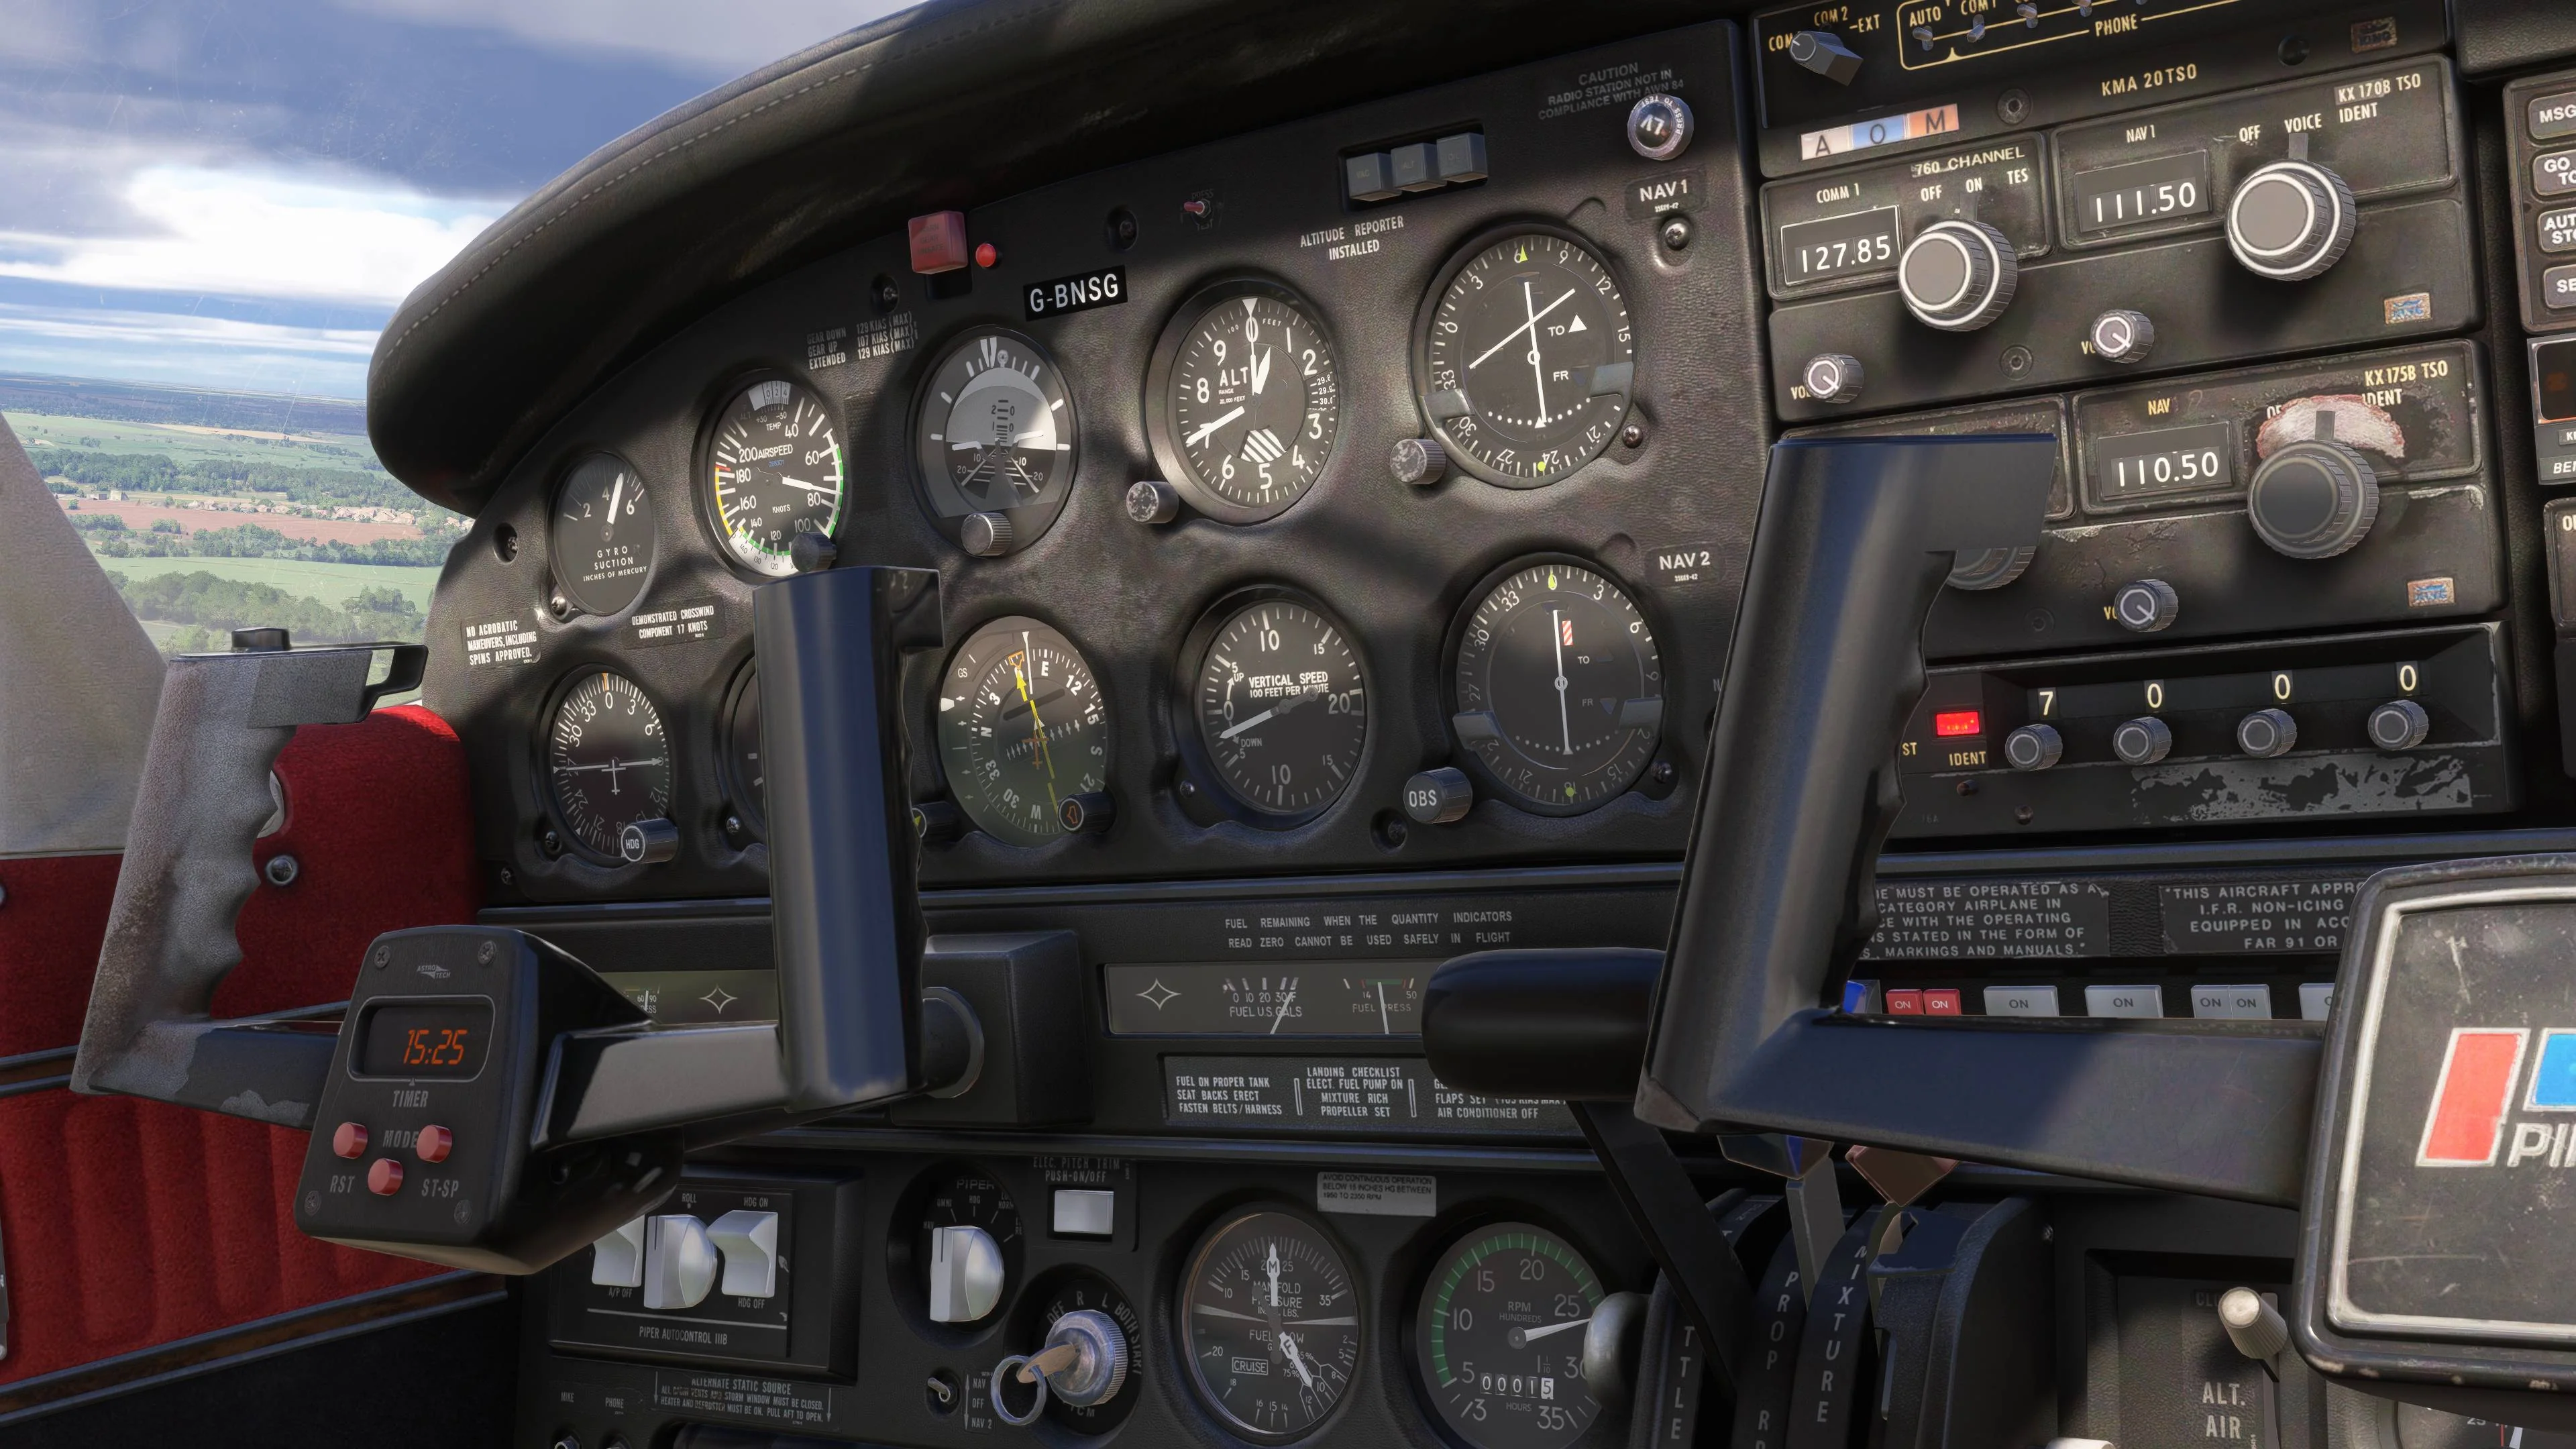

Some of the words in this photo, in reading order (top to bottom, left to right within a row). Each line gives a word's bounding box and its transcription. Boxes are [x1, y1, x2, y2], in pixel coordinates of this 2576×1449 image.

[1814, 9, 1836, 27] COM
[1839, 7, 1848, 21] 2
[1910, 6, 1941, 26] AUTO
[2095, 13, 2139, 37] PHONE
[1579, 62, 1638, 86] CAUTION
[2102, 74, 2137, 97] KMA
[2144, 70, 2162, 87] 20
[2165, 64, 2197, 83] TSO
[2339, 87, 2355, 103] KX
[2396, 74, 2421, 93] TSO
[1925, 110, 1945, 133] M
[2240, 124, 2261, 142] OFF
[2284, 113, 2322, 133] VOICE
[2339, 103, 2377, 123] IDENT
[2539, 104, 2576, 123] MSG
[2127, 126, 2147, 143] NAV
[2151, 125, 2155, 138] 1
[1815, 135, 1831, 157] A
[1916, 162, 1940, 176] 760
[1948, 147, 2025, 171] CHANNEL
[2544, 157, 2570, 172] GO
[1640, 181, 1676, 201] NAV
[1681, 179, 1687, 193] 1
[1817, 185, 1849, 203] COMM
[1856, 183, 1860, 196] 1
[1921, 185, 1941, 201] OFF
[1966, 177, 1982, 193] ON
[2096, 182, 2196, 223] 111.50
[1300, 227, 1344, 248] ALTITUDE
[1354, 215, 1404, 236] REPORTER
[1329, 239, 1379, 260] INSTALLED
[1803, 235, 1890, 273] 127.85
[1030, 273, 1118, 313] G-BNSG
[1548, 325, 1565, 337] TO
[809, 352, 846, 370] EXTENDED
[857, 347, 871, 360] 129
[873, 343, 890, 357] KIAS
[1214, 340, 1226, 366] 9
[1302, 349, 1318, 376] 2
[1219, 367, 1248, 386] ALT
[1553, 370, 1568, 381] FR
[2365, 369, 2383, 387] KX
[2422, 360, 2448, 378] TSO
[1197, 377, 1210, 403] 8
[1308, 413, 1322, 439] 3
[739, 446, 758, 463] 200
[758, 443, 793, 460] AIRSPEED
[805, 450, 820, 465] 60
[2118, 452, 2218, 486] 110.50
[772, 504, 791, 513] KNOTS
[597, 545, 628, 558] GYRO
[1659, 553, 1696, 570] NAV
[1700, 551, 1711, 566] 2
[594, 557, 634, 570] SUCTION
[583, 573, 605, 582] INCHES
[618, 566, 647, 577] MERCURY
[632, 611, 677, 625] DEMONSTRATED
[681, 605, 714, 619] CROSSWIND
[466, 626, 476, 637] NO
[479, 620, 518, 636] ACROBATIC
[639, 625, 673, 639] COMPONENT
[678, 624, 684, 634] 17
[688, 621, 708, 633] KNOTS
[1260, 629, 1280, 652] 10
[470, 652, 490, 665] SPINS
[496, 647, 532, 661] APPROVED.
[1041, 661, 1049, 676] E
[1233, 672, 1244, 682] UP
[1248, 674, 1293, 688] VERTICAL
[1299, 672, 1328, 684] SPEED
[1250, 688, 1263, 698] 100
[1265, 687, 1283, 697] FEET
[1285, 686, 1301, 696] PER
[2039, 692, 2053, 715] 7
[2147, 684, 2162, 708] 0
[2275, 674, 2290, 699] 0
[2400, 665, 2416, 690] 0
[1328, 692, 1350, 714] 20
[1949, 751, 1986, 766] IDENT
[1409, 790, 1437, 807] OBS
[626, 839, 639, 849] HDG
[1896, 888, 1935, 899] MUST
[1943, 886, 1962, 897] BE
[1970, 883, 2050, 897] OPERATED
[2059, 883, 2078, 894] AS
[2087, 883, 2096, 894] A
[2219, 884, 2300, 898] AIRCRAFT
[1878, 901, 1955, 914] CATEGORY
[1964, 899, 2038, 911] AIRPLANE
[2047, 898, 2061, 909] IN
[2200, 904, 2243, 915] I.F.R.
[2252, 899, 2344, 913] NON-ICING
[1226, 919, 1247, 928] FUEL
[1261, 917, 1310, 928] REMAINING
[1324, 916, 1350, 926] WHEN
[1359, 915, 1377, 924] THE
[1392, 913, 1438, 924] QUANTITY
[1454, 912, 1511, 922] INDICATORS
[2190, 919, 2271, 932] EQUIPPED
[2285, 918, 2301, 930] IN
[1229, 938, 1252, 948] READ
[1260, 937, 1283, 947] ZERO
[1295, 936, 1331, 947] CANNOT
[1341, 936, 1352, 945] BE
[1367, 934, 1391, 945] USED
[1404, 934, 1439, 944] SAFELY
[1451, 933, 1460, 943] IN
[1476, 932, 1510, 943] FLIGHT
[1894, 1000, 1911, 1009] ON
[1931, 1000, 1948, 1009] ON
[2009, 1000, 2029, 1009] ON
[403, 1029, 468, 1065] 15:25
[1307, 1067, 1344, 1077] LANDING
[1352, 1067, 1400, 1077] CHECKLIST
[1177, 1076, 1195, 1087] FUEL
[1199, 1077, 1209, 1087] ON
[1213, 1077, 1244, 1087] PROPER
[1248, 1077, 1270, 1087] TANK
[393, 1091, 429, 1108] TIMER
[1177, 1089, 1195, 1100] SEAT
[1201, 1090, 1228, 1100] BACKS
[1234, 1090, 1258, 1101] ERECT
[1322, 1093, 1360, 1103] MIXTURE
[1368, 1093, 1388, 1104] RICH
[1321, 1106, 1368, 1116] PROPELLER
[1375, 1107, 1391, 1118] SET
[1438, 1108, 1452, 1118] AIR
[1457, 1108, 1517, 1118] CONDITIONER
[1521, 1108, 1538, 1118] OFF
[383, 1130, 418, 1148] MODE
[330, 1175, 355, 1193] RST
[1046, 1170, 1106, 1183] PUSH-ON/OFF
[421, 1179, 460, 1198] ST-SP
[744, 1197, 757, 1207] HDG
[759, 1198, 768, 1208] ON
[1520, 1259, 1544, 1281] 20
[1478, 1271, 1494, 1292] 15
[1508, 1301, 1531, 1312] RPM
[1554, 1294, 1580, 1317] 25
[1499, 1312, 1542, 1324] HUNDREDS
[639, 1327, 659, 1339] PIPER
[662, 1328, 711, 1344] AUTOCONTROL
[1234, 1360, 1267, 1373] CRUISE
[733, 1379, 758, 1392] STATIC
[762, 1382, 791, 1395] SOURCE
[2202, 1381, 2246, 1406] ALT.
[1506, 1402, 1532, 1411] HOURS
[971, 1418, 986, 1428] NAV
[1537, 1406, 1564, 1430] 35
[2206, 1415, 2241, 1440] AIR
